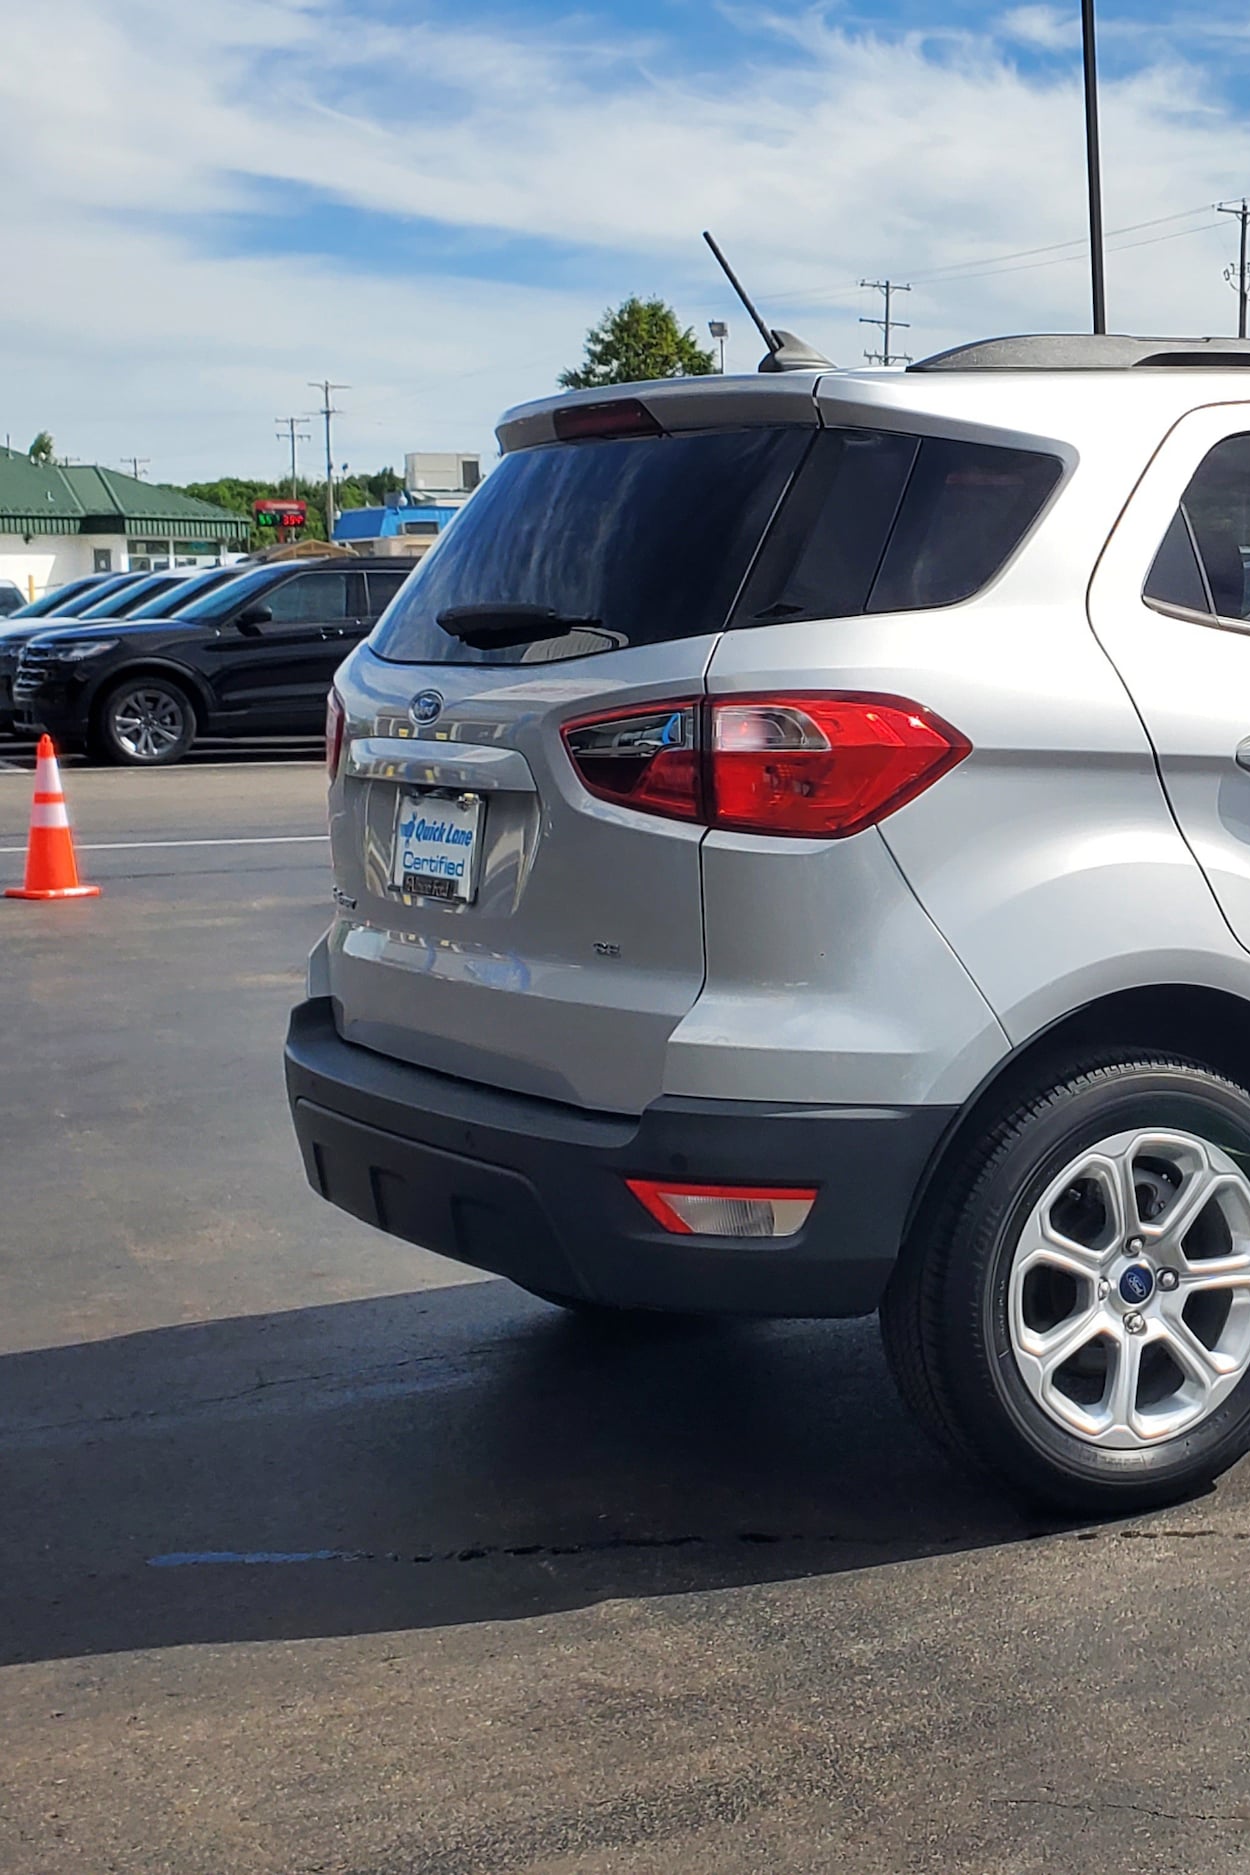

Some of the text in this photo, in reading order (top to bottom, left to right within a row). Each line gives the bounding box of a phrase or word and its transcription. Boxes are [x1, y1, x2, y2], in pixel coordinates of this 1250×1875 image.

[415, 818, 473, 847] Quick Lane
[402, 851, 464, 877] Certified
